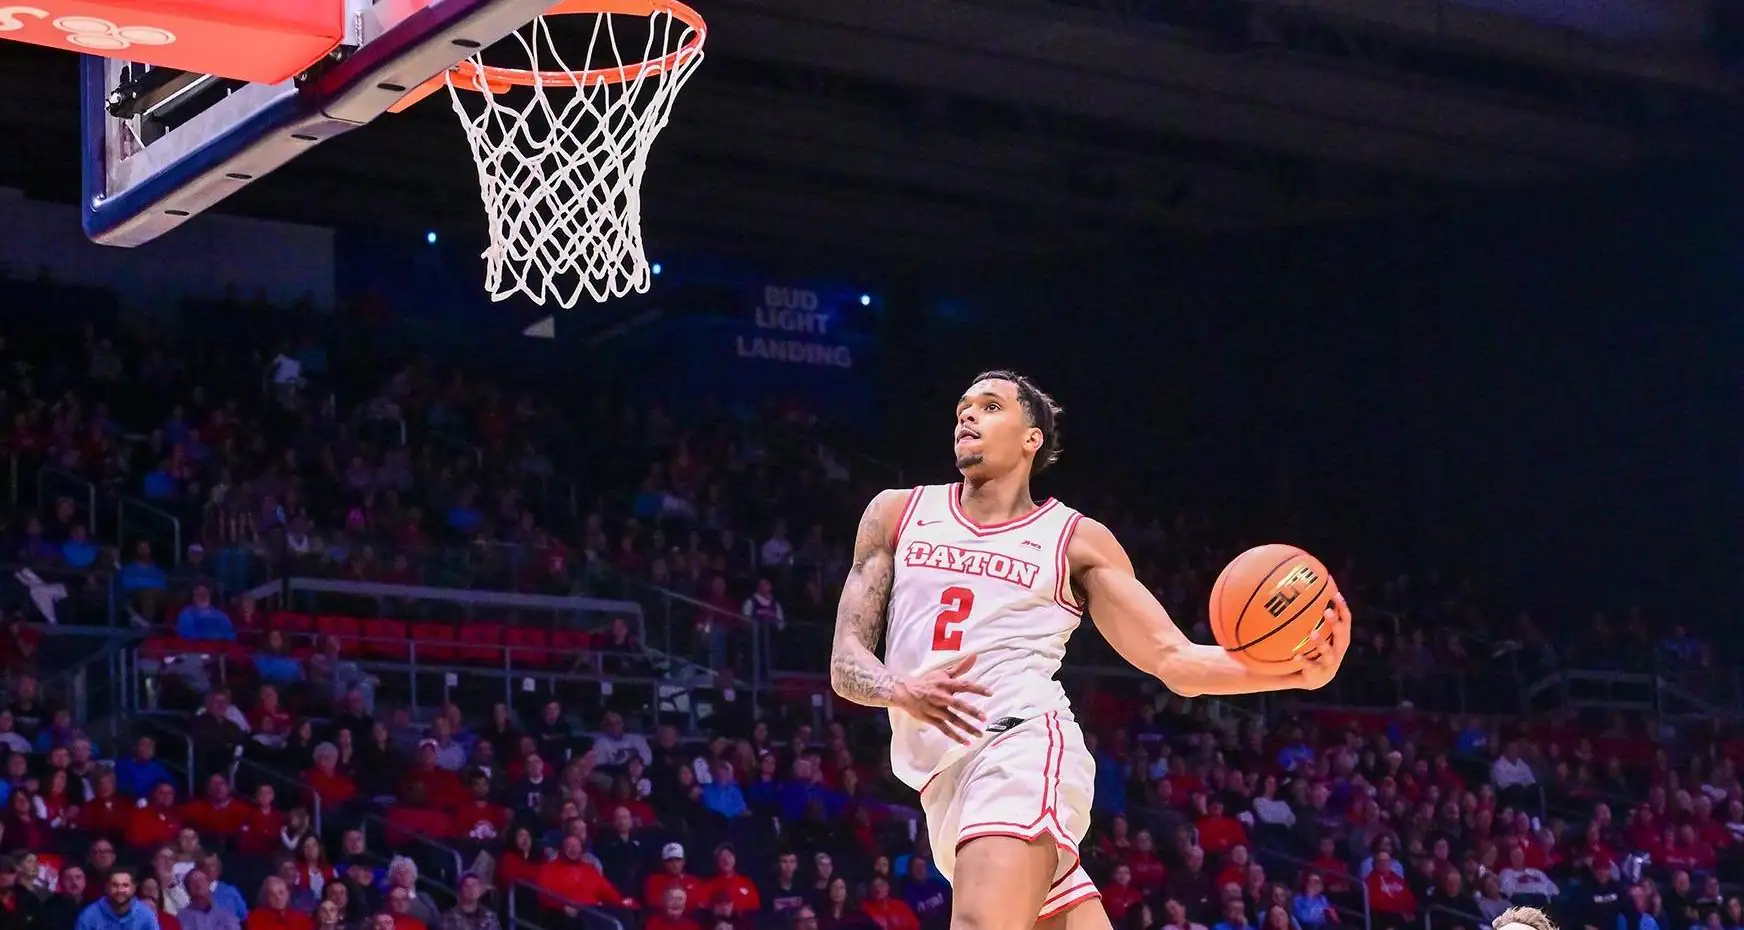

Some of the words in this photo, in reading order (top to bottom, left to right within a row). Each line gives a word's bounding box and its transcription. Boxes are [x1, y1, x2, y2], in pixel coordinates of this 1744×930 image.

[764, 285, 818, 311] BUD
[755, 306, 830, 334] LIGHT
[736, 335, 852, 368] LANDING
[904, 541, 1040, 589] DAYTON
[931, 586, 975, 651] 2
